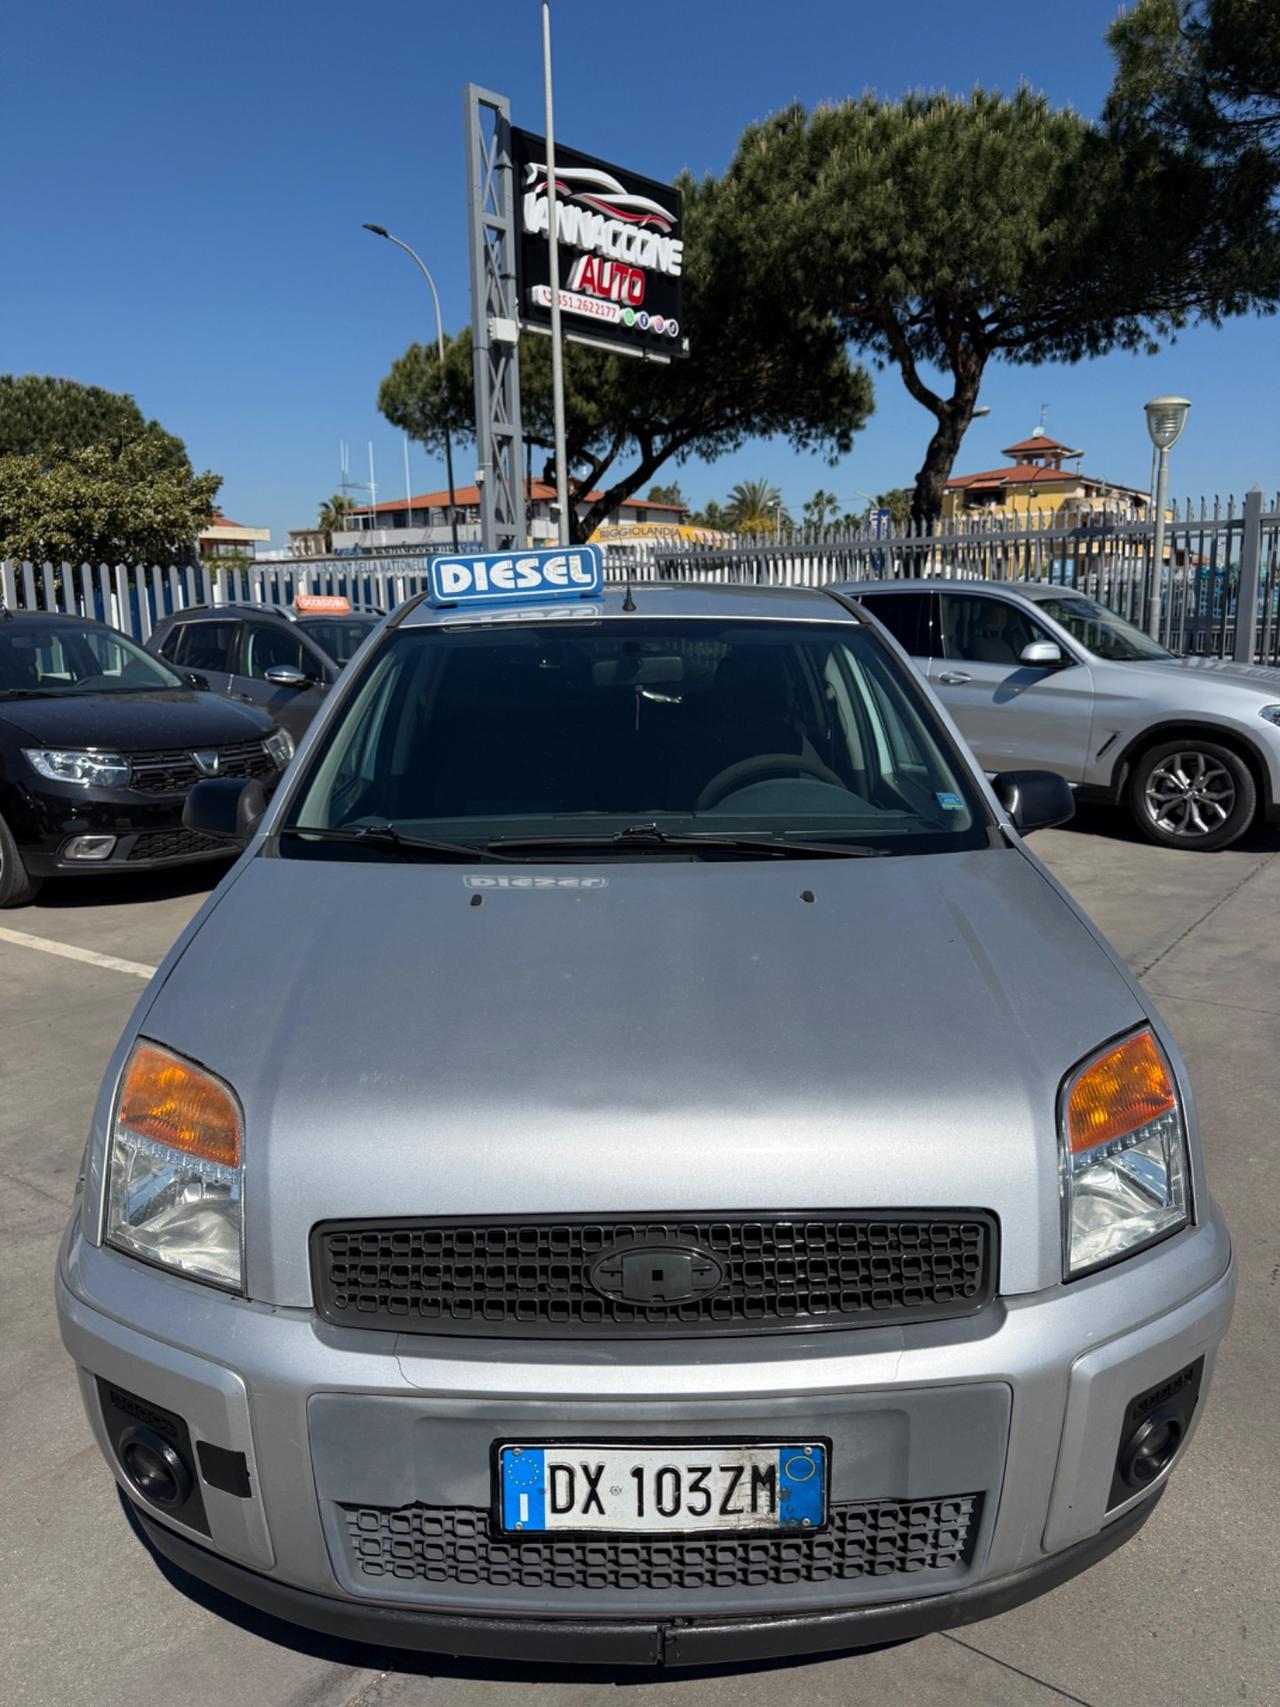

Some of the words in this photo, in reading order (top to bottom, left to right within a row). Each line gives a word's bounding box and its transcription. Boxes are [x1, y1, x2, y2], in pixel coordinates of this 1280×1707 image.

[573, 254, 646, 306] AUTO
[599, 526, 681, 539] RIGGIOLANDIA
[440, 554, 593, 595] DIESEL
[548, 1463, 606, 1516] DX
[631, 1464, 777, 1518] 103ZM
